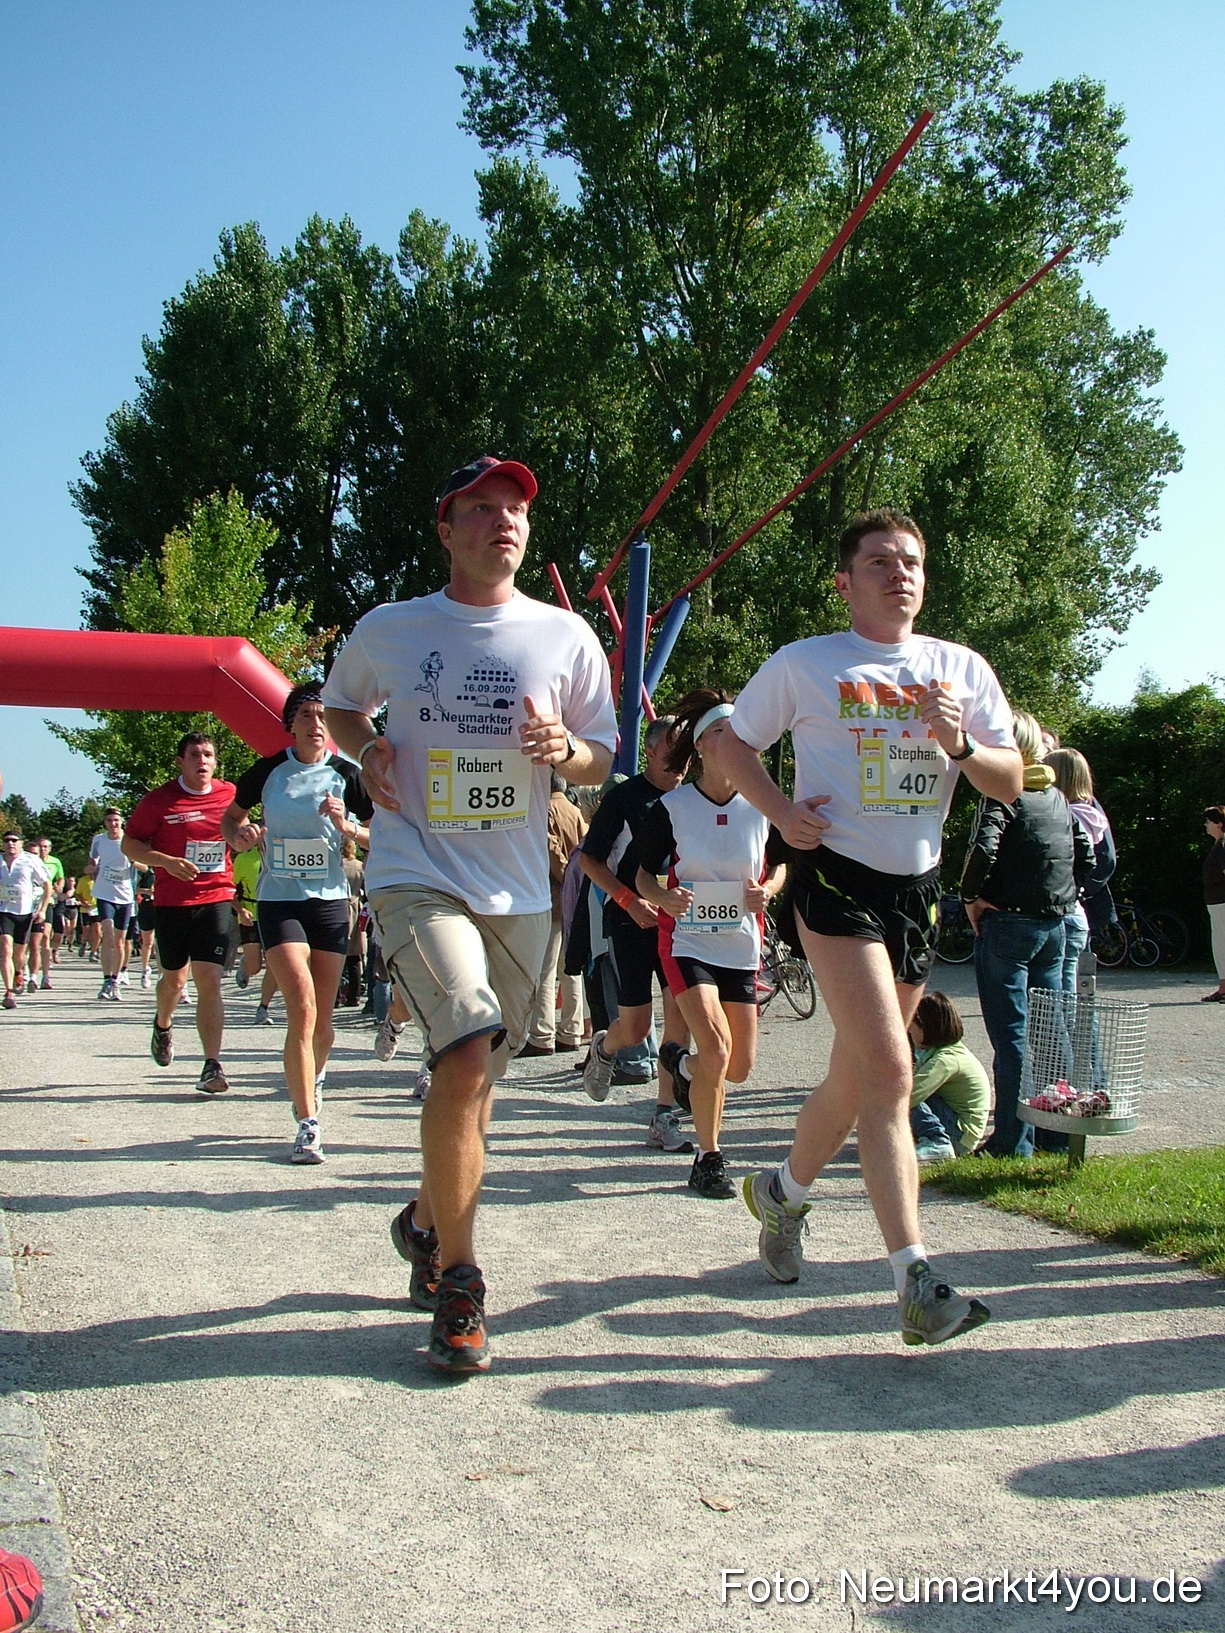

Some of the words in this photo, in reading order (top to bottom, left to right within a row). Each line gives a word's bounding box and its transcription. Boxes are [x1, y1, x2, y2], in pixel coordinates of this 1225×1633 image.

[463, 684, 517, 694] 16.09.2007
[838, 681, 952, 707] MER
[420, 707, 437, 722] 8.
[441, 711, 513, 725] Neumarkter
[457, 723, 513, 736] Stadtlauf
[889, 745, 937, 763] Stephan
[457, 757, 503, 773] Robert
[866, 767, 873, 779] B
[432, 781, 440, 793] C
[899, 773, 938, 795] 407
[468, 786, 515, 809] 858
[198, 853, 223, 863] 2072
[288, 853, 324, 867] 3683
[697, 905, 738, 919] 3686
